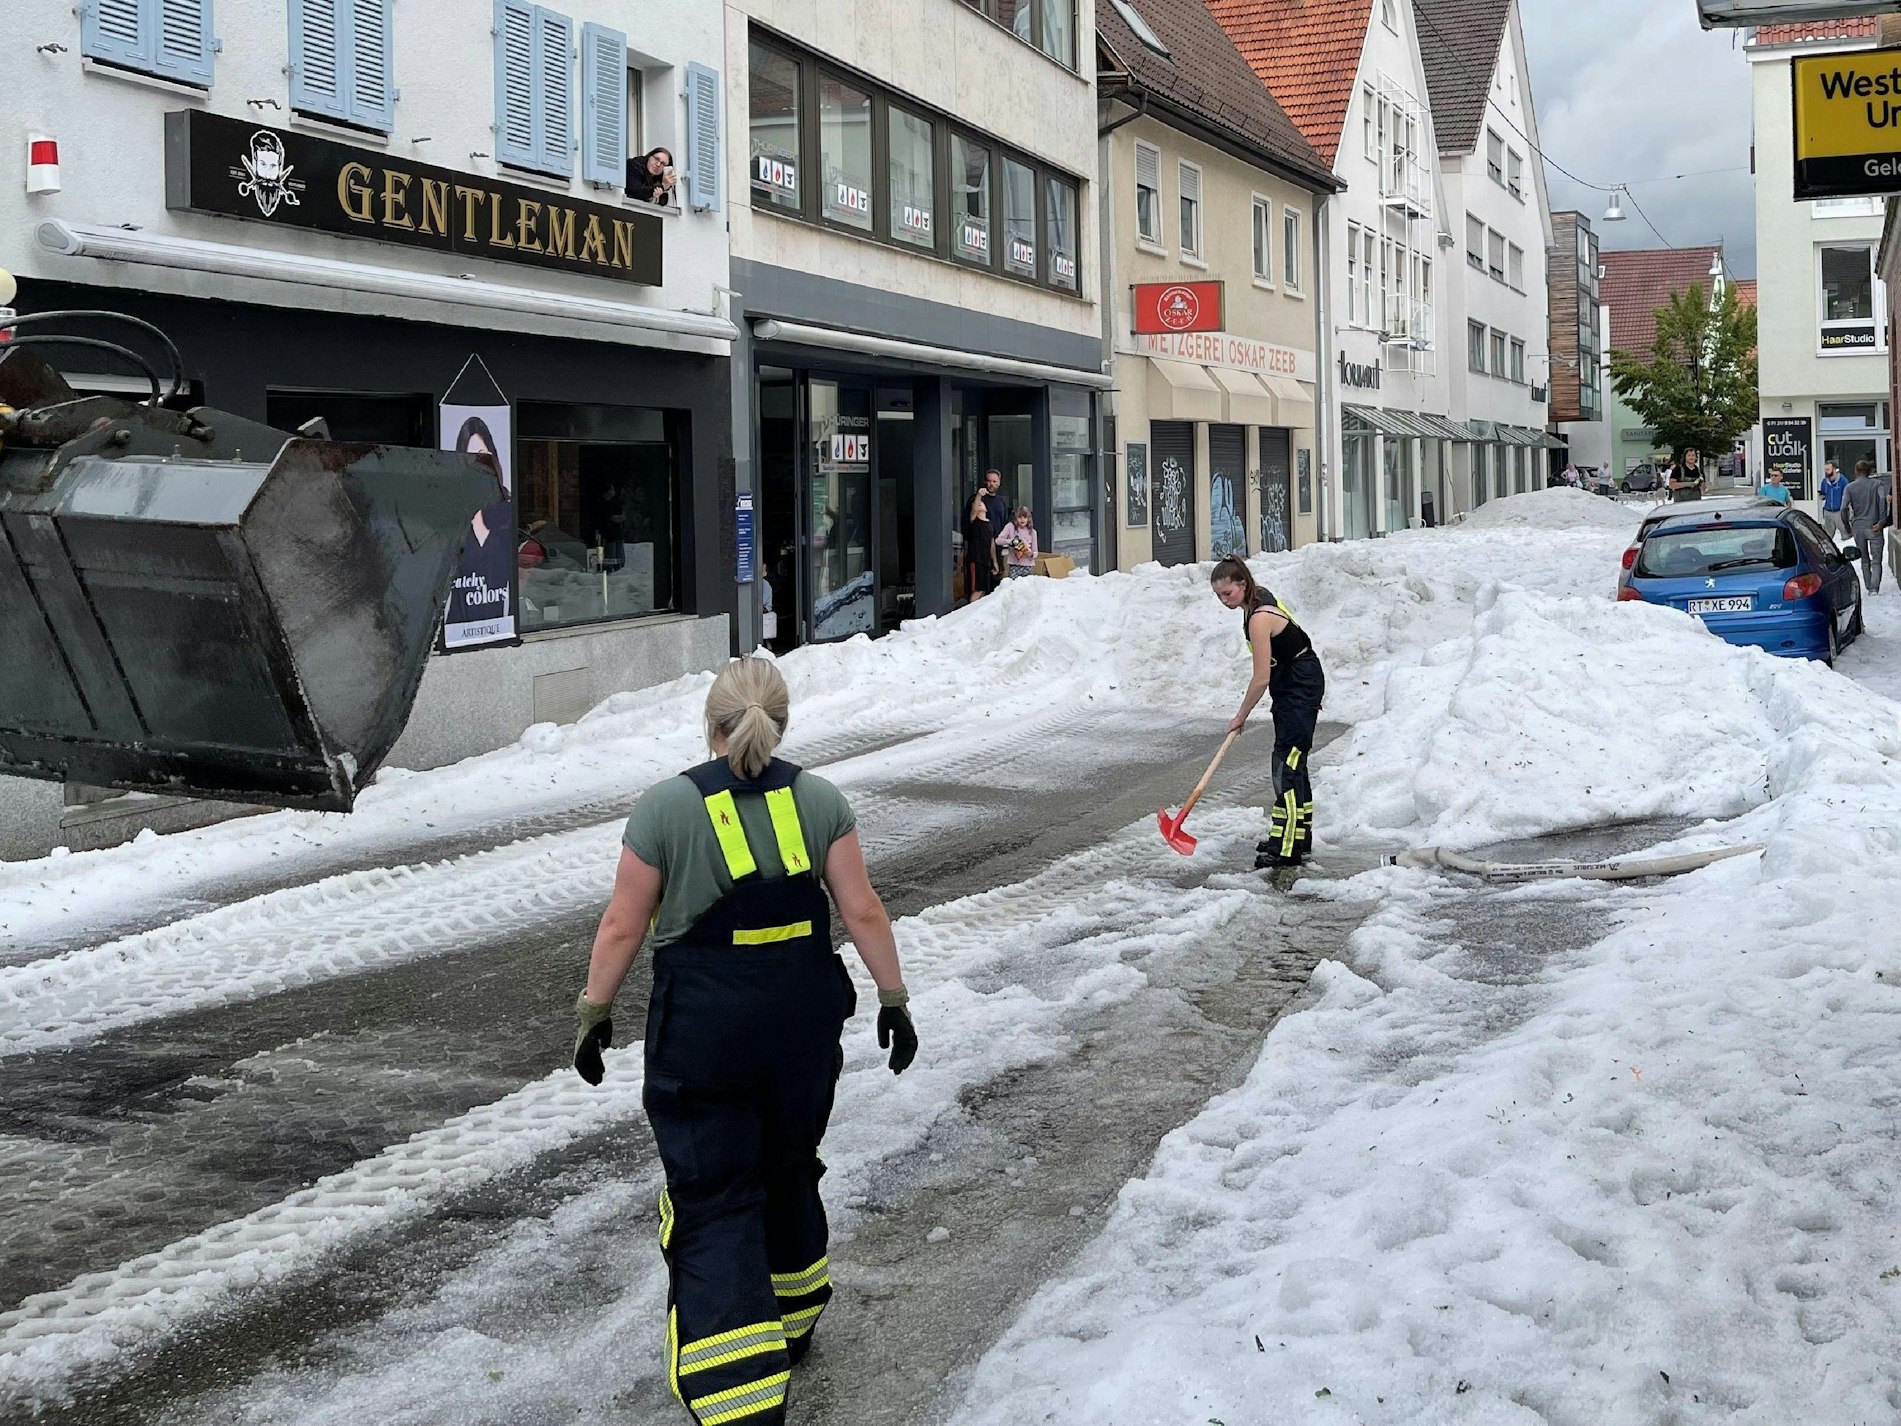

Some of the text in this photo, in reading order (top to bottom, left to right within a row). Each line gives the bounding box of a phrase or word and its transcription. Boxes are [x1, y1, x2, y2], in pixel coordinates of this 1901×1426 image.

[337, 161, 635, 271] GENTLEMAN
[1164, 308, 1193, 316] OSKAR
[1821, 333, 1876, 346] HaarStudio
[1148, 333, 1296, 374] METZGEREI OSKAR ZEEB
[1767, 431, 1793, 445] cut
[1767, 440, 1807, 457] walk
[465, 584, 509, 606] colors
[1689, 599, 1750, 612] RT XE 994
[462, 624, 500, 638] ARTISTIQUE
